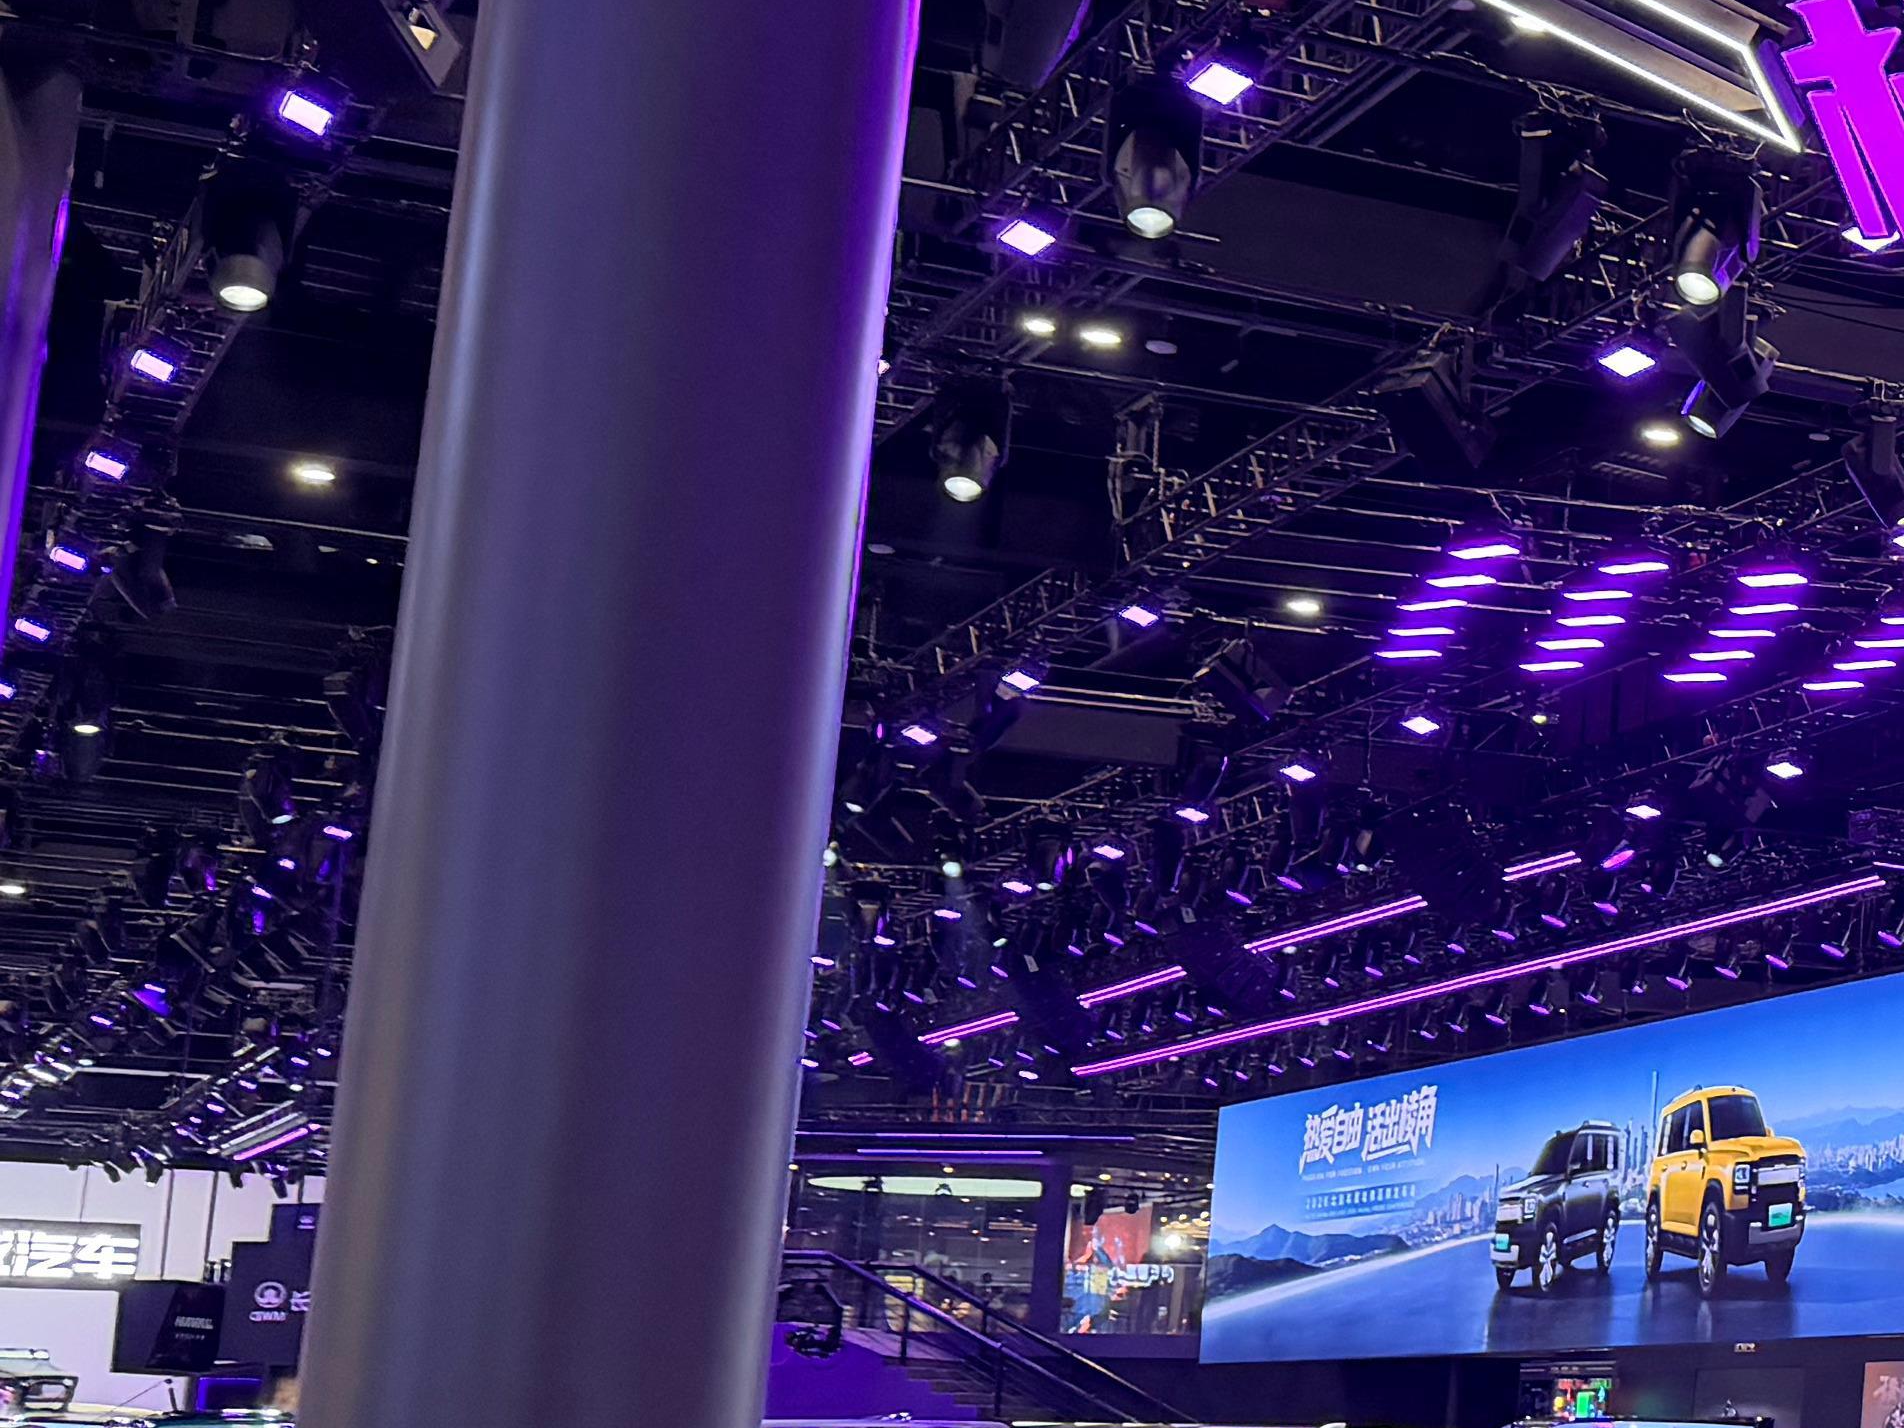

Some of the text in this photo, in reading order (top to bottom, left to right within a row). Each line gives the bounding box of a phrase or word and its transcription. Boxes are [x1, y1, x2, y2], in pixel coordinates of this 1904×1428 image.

[1299, 1085, 1438, 1175] 热爱自由 活出棱角
[0, 1229, 140, 1280] 汽车
